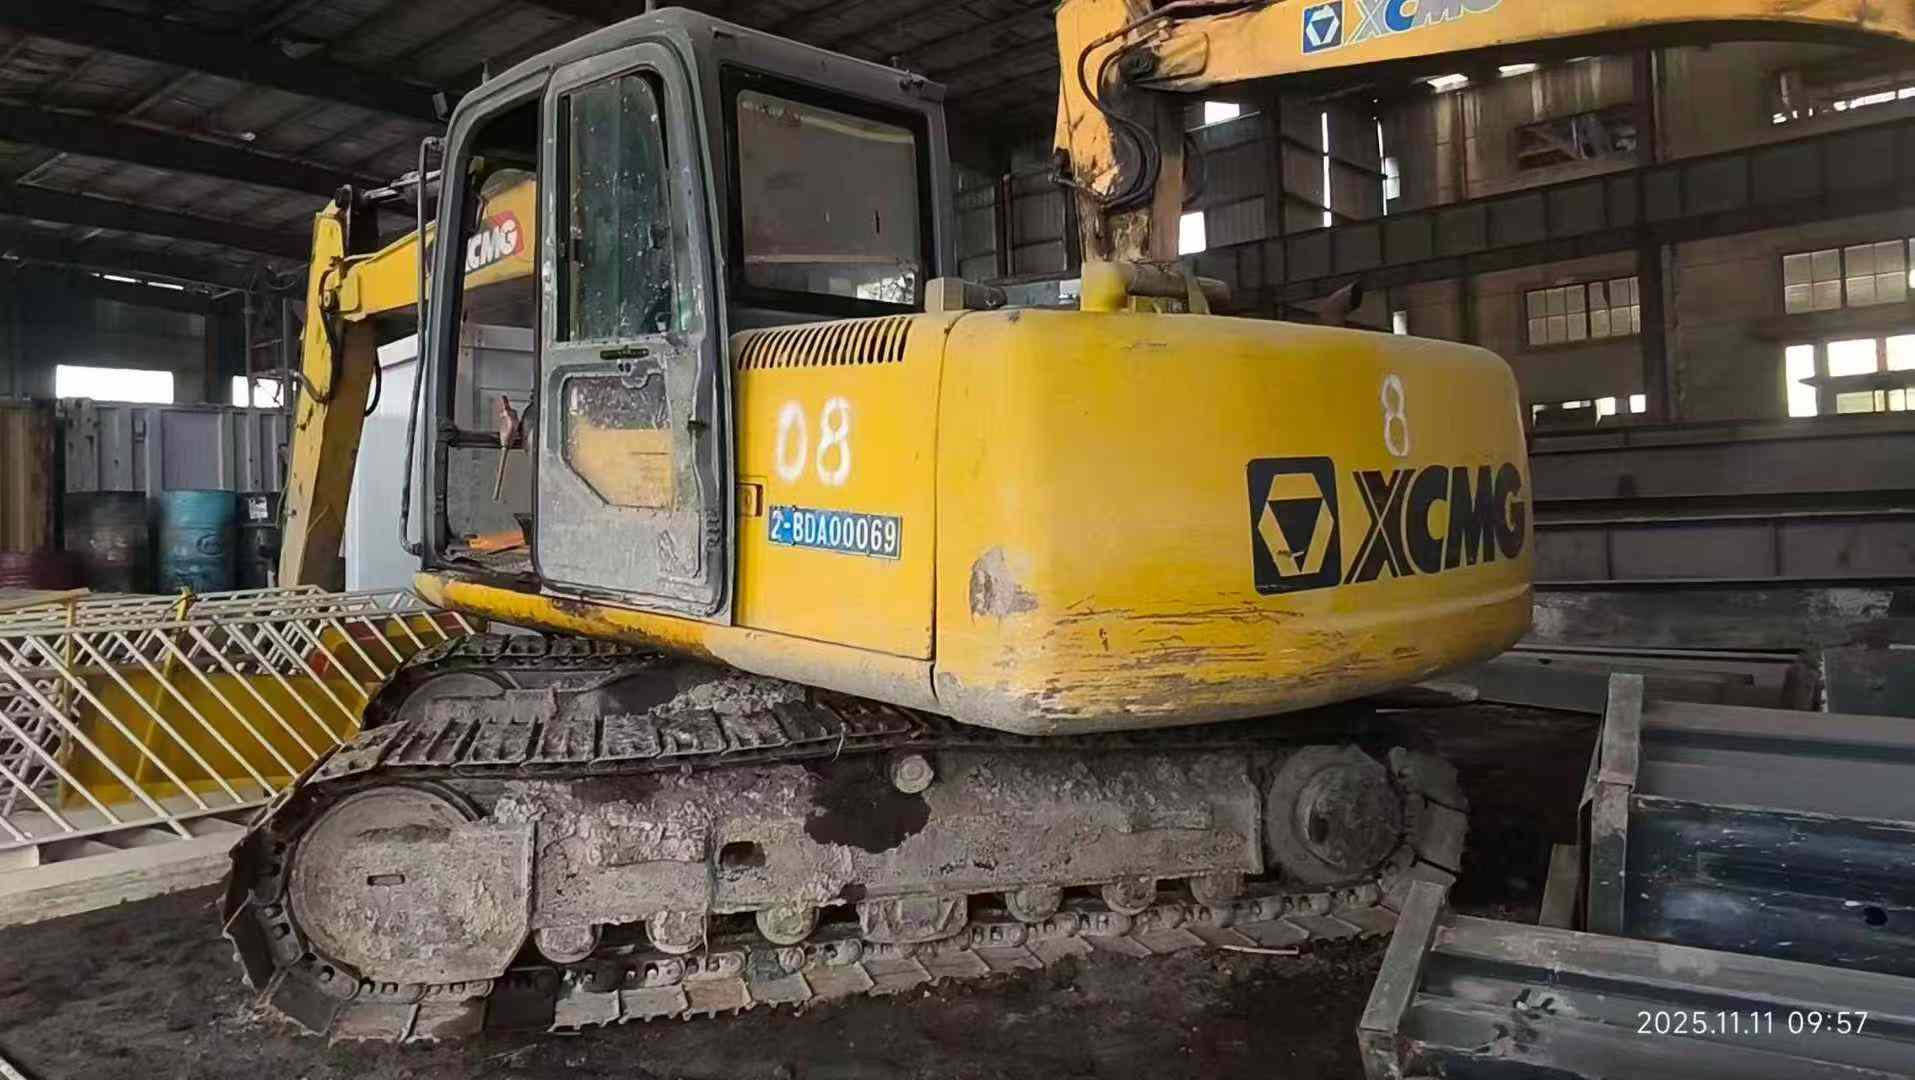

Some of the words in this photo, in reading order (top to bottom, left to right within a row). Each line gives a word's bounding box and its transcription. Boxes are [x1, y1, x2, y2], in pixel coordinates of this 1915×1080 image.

[776, 397, 851, 486] 08
[770, 510, 897, 554] 2-BDA00069
[1343, 462, 1525, 584] XCMG
